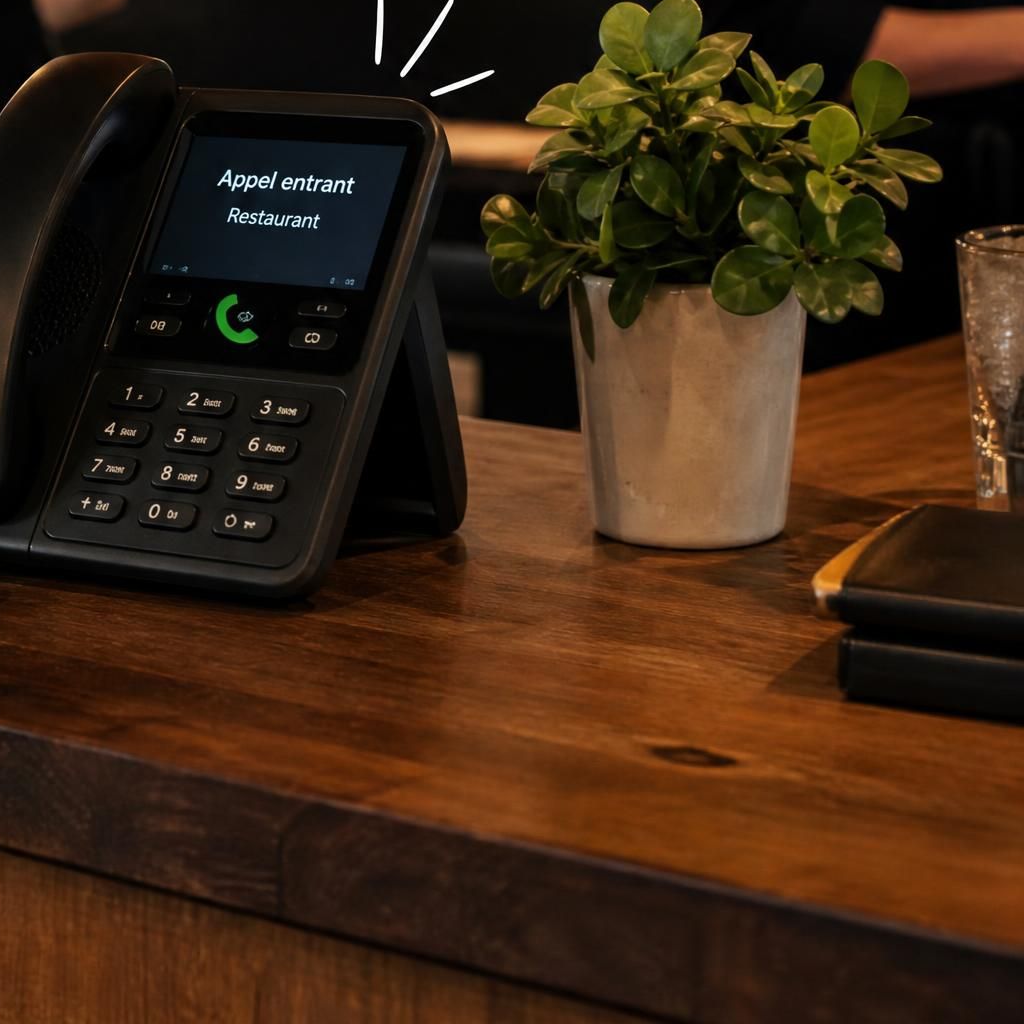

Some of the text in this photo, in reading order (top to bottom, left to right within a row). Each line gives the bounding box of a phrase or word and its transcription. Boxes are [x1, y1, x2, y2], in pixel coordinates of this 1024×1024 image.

[216, 169, 356, 195] Appel entrant
[226, 207, 321, 230] Restaurant
[125, 386, 133, 401] 1
[186, 392, 200, 407] 2
[259, 399, 272, 415] 3
[104, 422, 116, 436] 4
[173, 428, 187, 443] 5
[248, 437, 261, 452] 6
[91, 458, 104, 472] 7
[160, 465, 173, 481] 8
[235, 474, 248, 490] 9
[148, 503, 161, 519] 0
